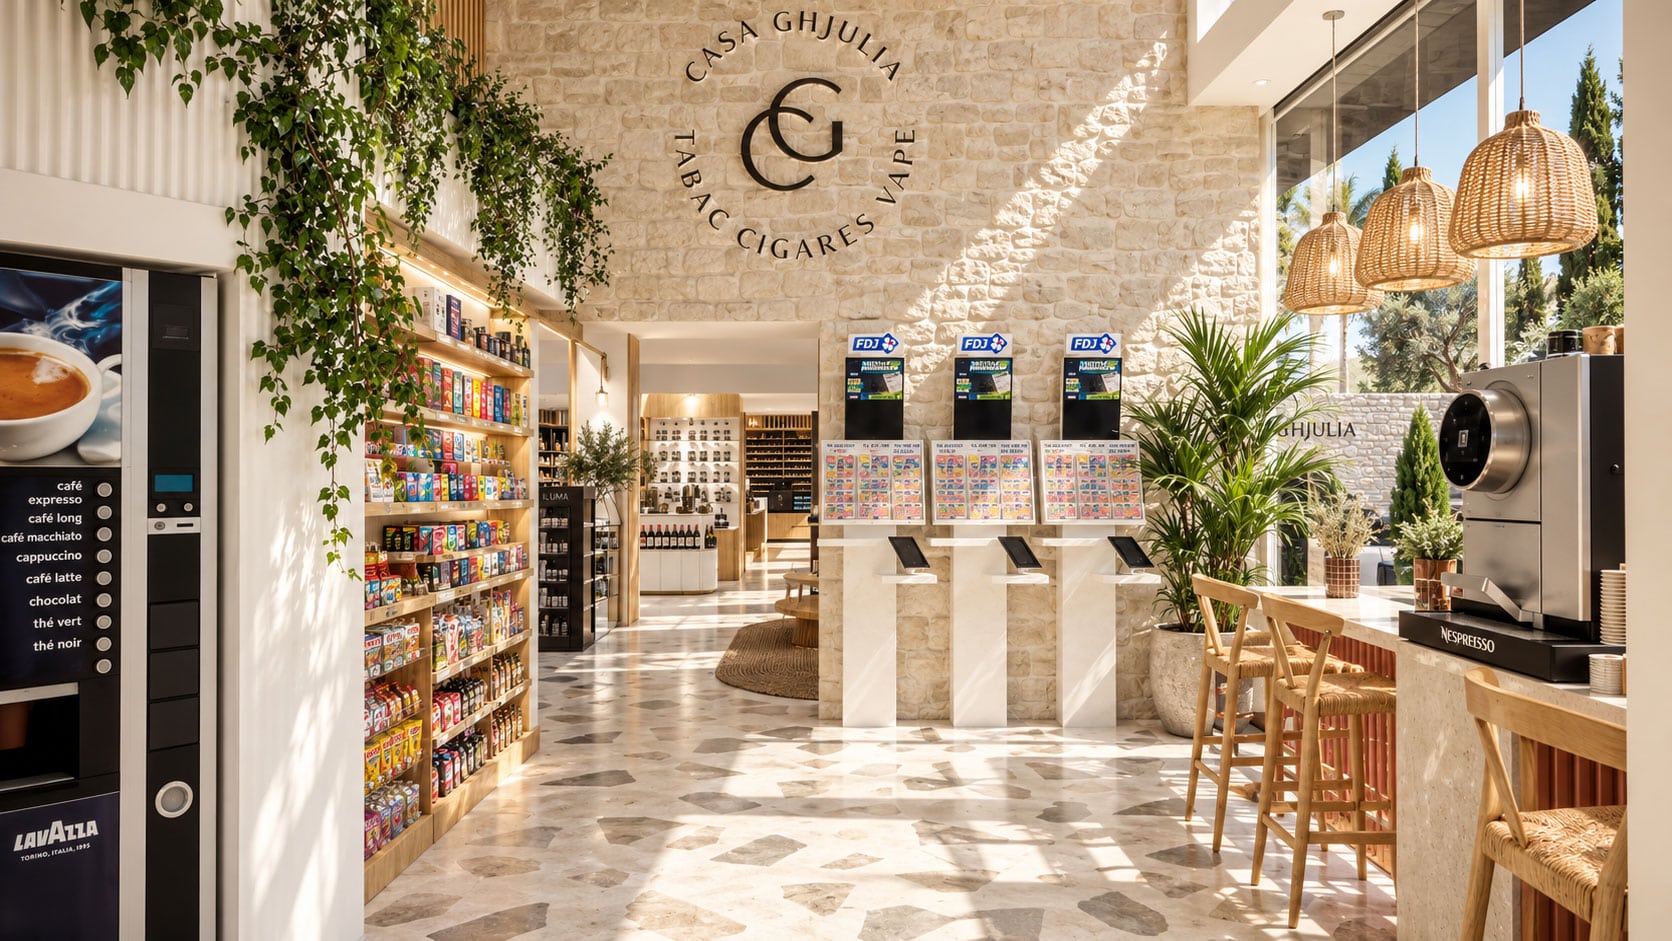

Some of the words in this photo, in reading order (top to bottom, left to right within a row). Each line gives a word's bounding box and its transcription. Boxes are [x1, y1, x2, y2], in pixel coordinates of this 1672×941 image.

[686, 20, 758, 82] CASA
[773, 11, 900, 81] GHJULIA
[674, 129, 730, 230] TABAC
[737, 213, 874, 259] CIGARES
[875, 129, 915, 206] VAPE
[856, 338, 880, 349] FDJ
[964, 338, 988, 349] FDJ
[1074, 338, 1098, 349] FDJ
[57, 481, 83, 491] café
[28, 496, 83, 507] expresso
[28, 513, 54, 524] café
[57, 513, 82, 525] long
[1, 532, 25, 543] café
[27, 531, 82, 542] macchiato
[16, 550, 82, 564] cappuccino
[26, 573, 52, 585] café
[55, 572, 82, 583] latte
[29, 594, 82, 607] chocolat
[33, 617, 54, 629] thé
[58, 616, 82, 627] vert
[33, 639, 54, 651] thé
[58, 638, 82, 649] noir
[13, 820, 99, 852] LAVAZZA
